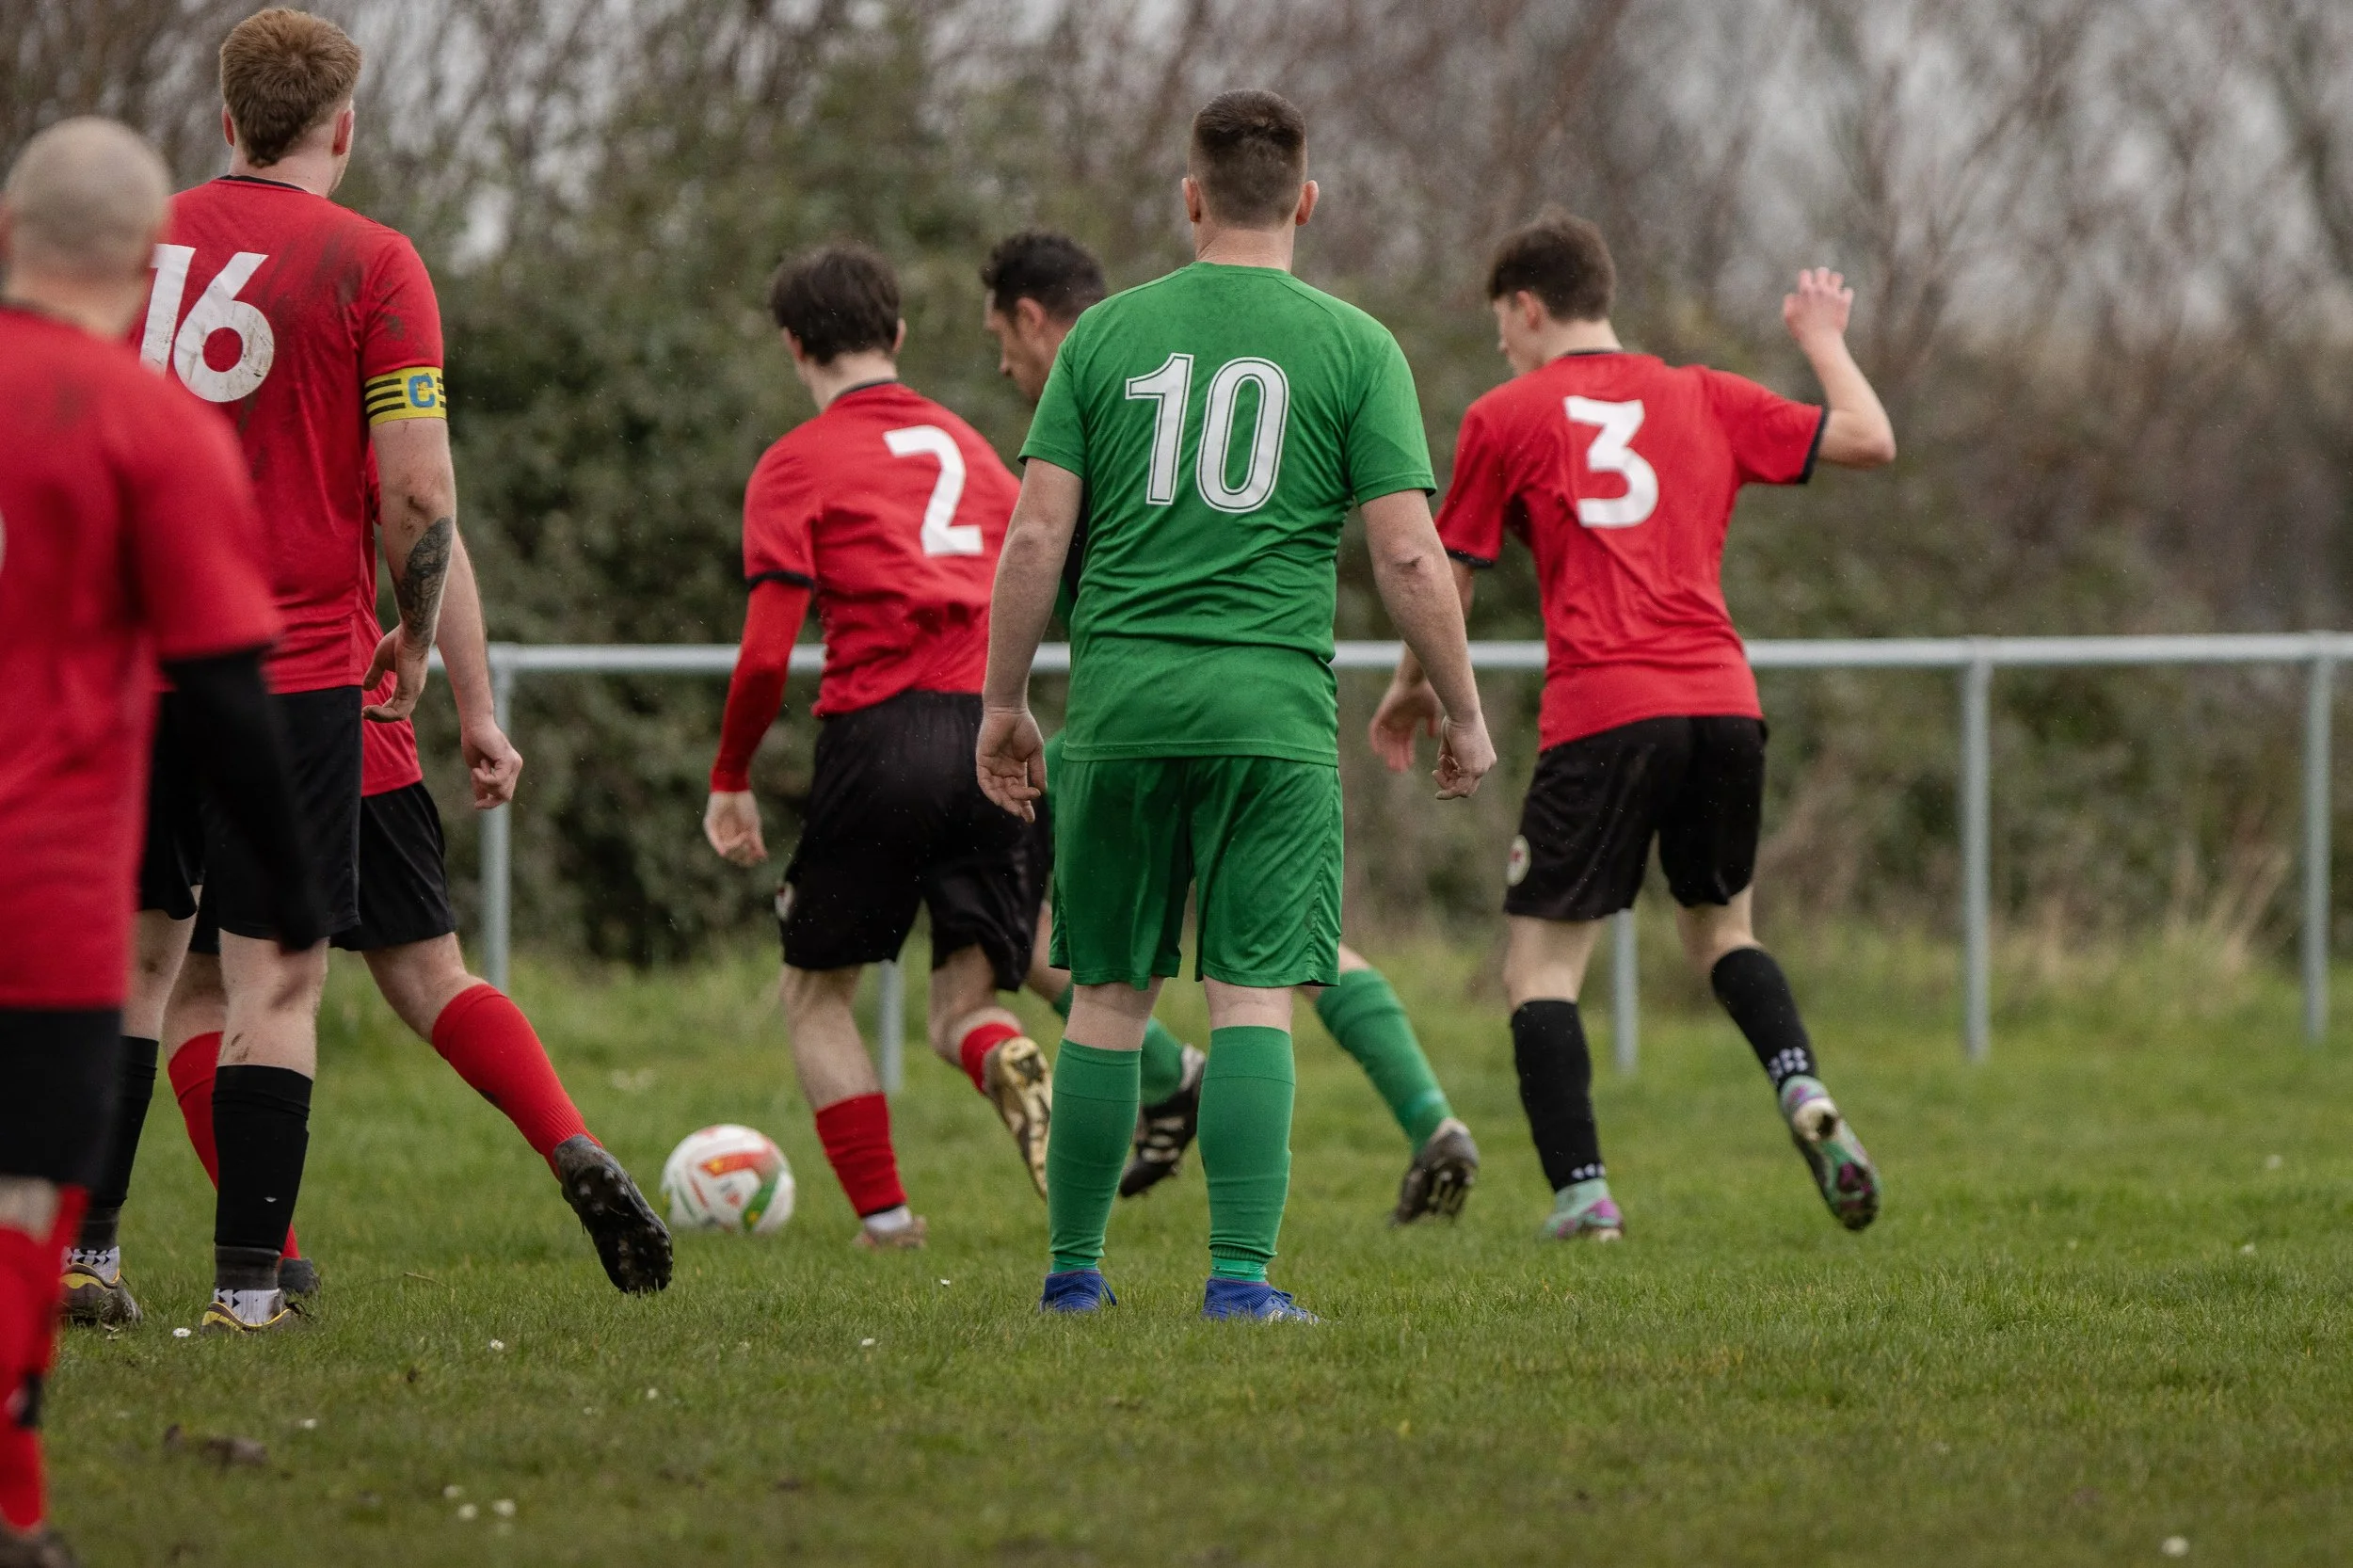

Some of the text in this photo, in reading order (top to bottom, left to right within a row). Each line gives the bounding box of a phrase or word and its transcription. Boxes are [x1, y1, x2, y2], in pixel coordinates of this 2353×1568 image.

[140, 244, 275, 403] 16
[408, 375, 436, 408] C
[1124, 352, 1290, 514] 10
[884, 425, 984, 557] 2
[1564, 396, 1658, 528] 3
